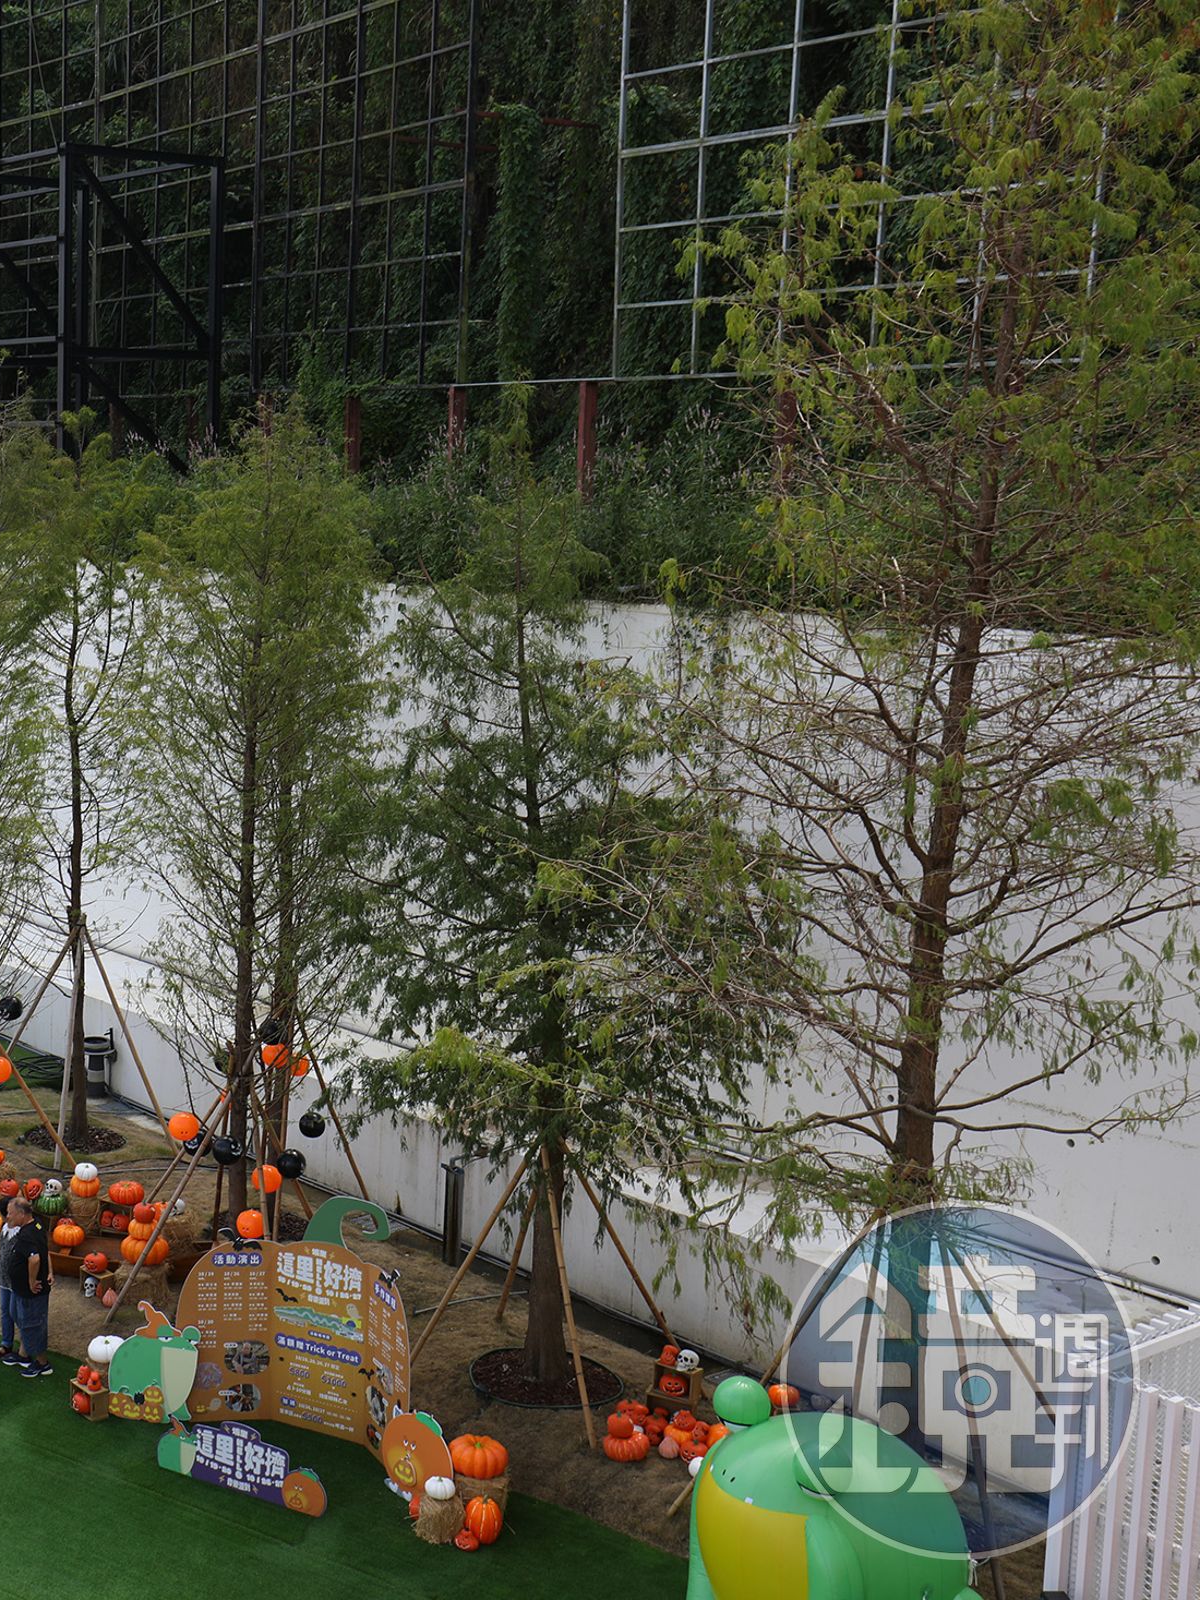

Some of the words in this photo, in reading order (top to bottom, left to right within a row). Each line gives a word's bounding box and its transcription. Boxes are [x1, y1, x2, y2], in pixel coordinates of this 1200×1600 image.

[214, 1254, 260, 1265] 活動演出
[305, 1343, 326, 1355] Trick
[326, 1348, 335, 1357] or
[337, 1351, 359, 1363] Treat
